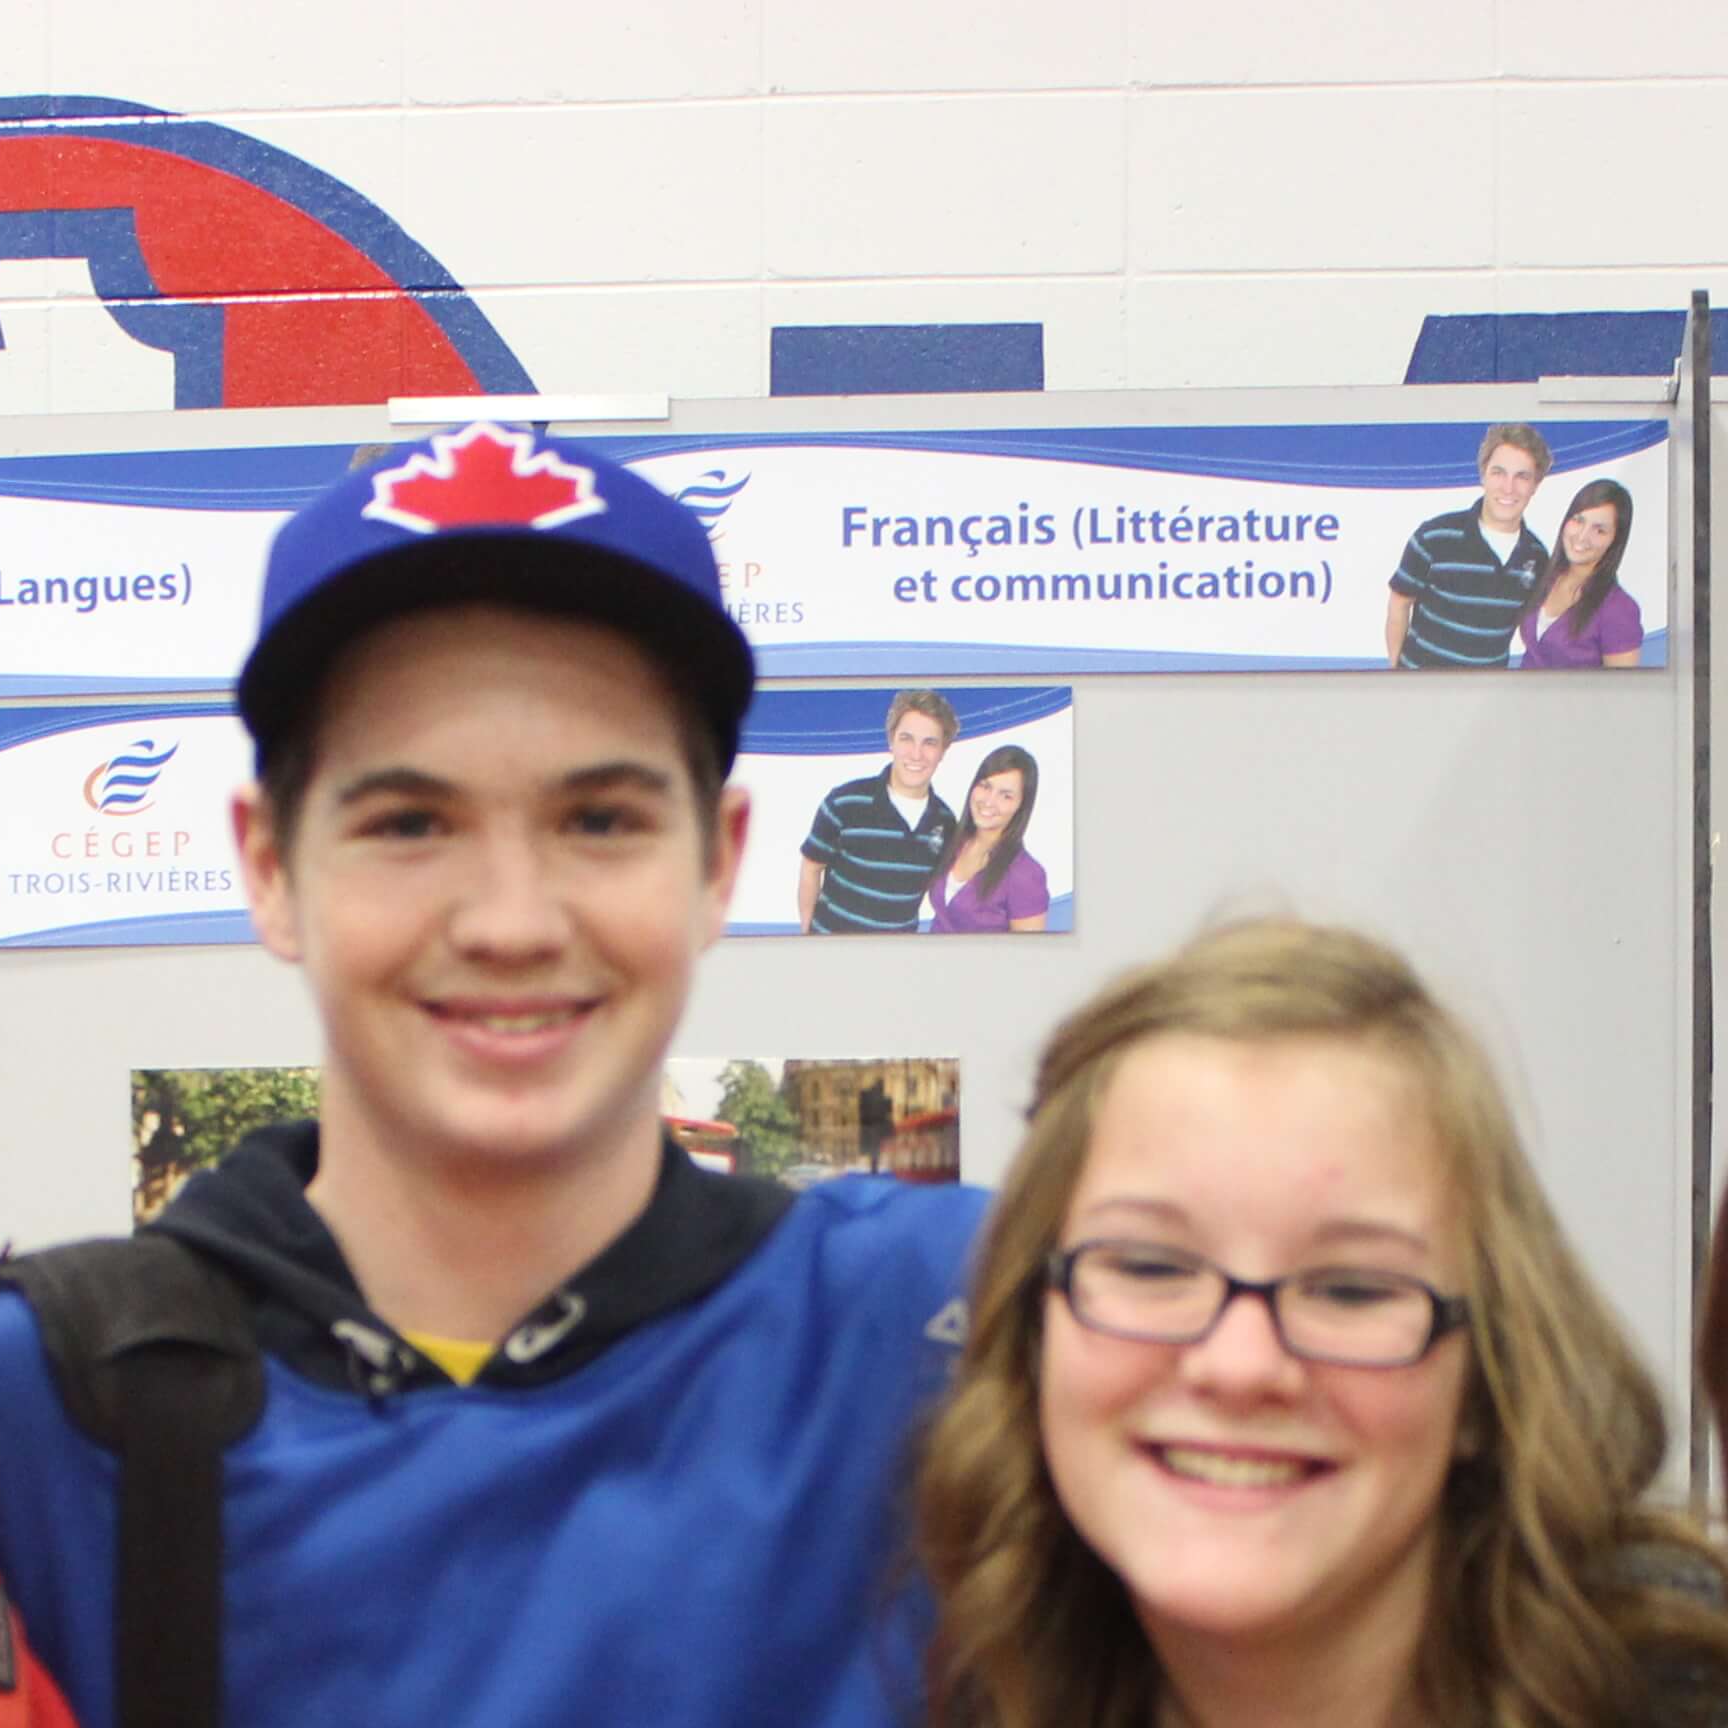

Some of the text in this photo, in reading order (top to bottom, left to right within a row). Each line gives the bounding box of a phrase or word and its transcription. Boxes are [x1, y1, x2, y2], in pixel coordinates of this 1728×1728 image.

[841, 502, 1341, 557] Français (Littérature
[892, 558, 1335, 606] et communication)
[51, 824, 193, 860] CÉGEP
[8, 864, 233, 896] TROIS-RIVIÈRES
